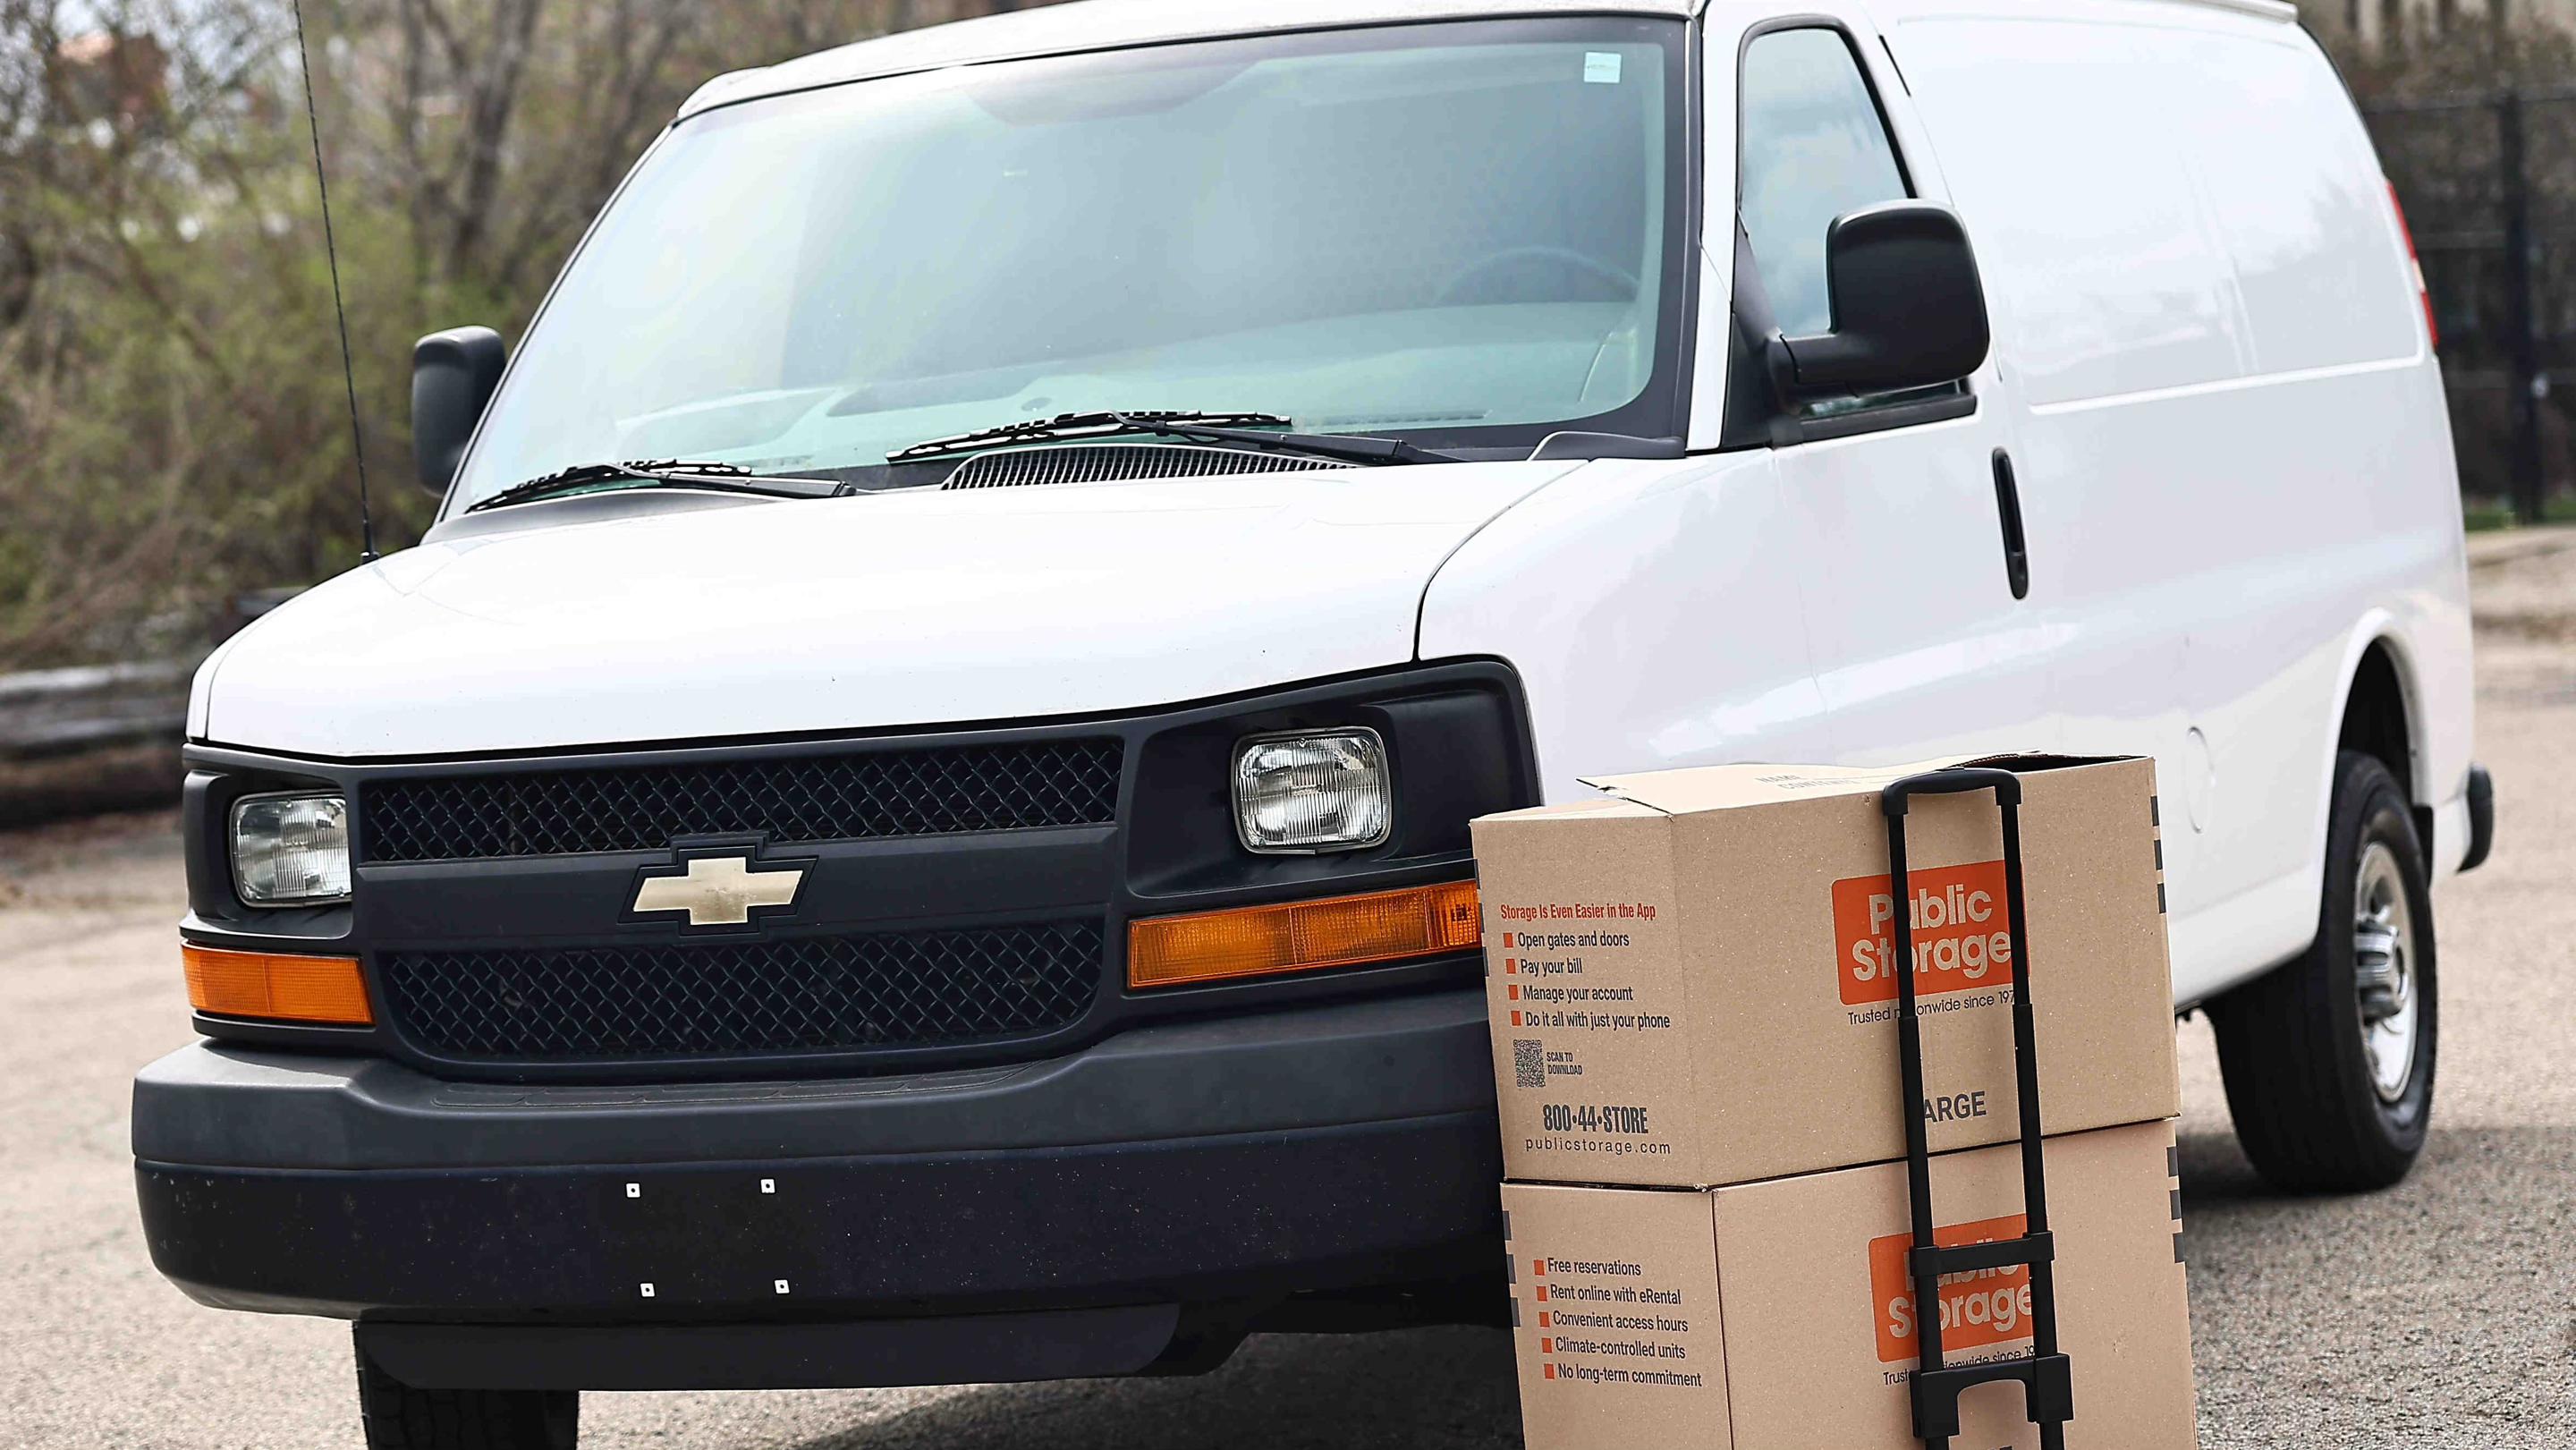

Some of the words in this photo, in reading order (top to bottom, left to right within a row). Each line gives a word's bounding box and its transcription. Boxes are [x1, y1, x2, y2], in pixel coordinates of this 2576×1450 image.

[1501, 904, 1537, 921] Storage
[1539, 904, 1548, 919] Is
[1550, 904, 1572, 919] Even
[1575, 903, 1604, 919] Easier
[1607, 903, 1616, 919] in
[1618, 903, 1634, 919] the
[1637, 903, 1656, 920] App
[1518, 932, 1545, 950] Open
[1547, 933, 1576, 950] gates
[1578, 931, 1597, 946] and
[1600, 931, 1630, 946] doors
[1521, 959, 1539, 977] Pay
[1542, 962, 1565, 977] your
[1567, 958, 1582, 973] bill
[1523, 986, 1564, 1004] Manage
[1566, 988, 1589, 1004] your
[1592, 987, 1633, 1001] account
[1848, 1007, 1890, 1025] Trusted
[1894, 998, 1961, 1018] nonwide
[1964, 994, 1995, 1009] since
[1998, 989, 2014, 1004] 197
[1525, 1012, 1540, 1027] Do
[1542, 1012, 1550, 1027] it
[1552, 1012, 1563, 1027] all
[1566, 1012, 1589, 1027] with
[1590, 1012, 1610, 1031] just
[1613, 1013, 1635, 1031] your
[1638, 1012, 1670, 1031] phone
[1546, 1052, 1563, 1062] SCAN
[1563, 1053, 1573, 1062] TO
[1547, 1064, 1582, 1075] DOWNLOAD
[1924, 1090, 1987, 1123] ARGE
[1526, 1137, 1671, 1155] publicstorage.com
[1547, 1258, 1572, 1273] Free
[1574, 1259, 1641, 1276] reservations
[1550, 1284, 1576, 1300] Rent
[1578, 1285, 1611, 1301] online
[1613, 1287, 1637, 1302] with
[1640, 1288, 1682, 1305] eRental
[1889, 1283, 2032, 1337] Srage
[1553, 1310, 1614, 1327] Convenient
[1615, 1317, 1654, 1330] access
[1657, 1316, 1689, 1332] hours
[1555, 1336, 1655, 1357] Climate-controlled
[1658, 1344, 1686, 1359] units
[1558, 1363, 1573, 1378] No
[1576, 1363, 1629, 1384] long-term
[1631, 1369, 1702, 1387] commitment
[1883, 1368, 1909, 1386] Trust
